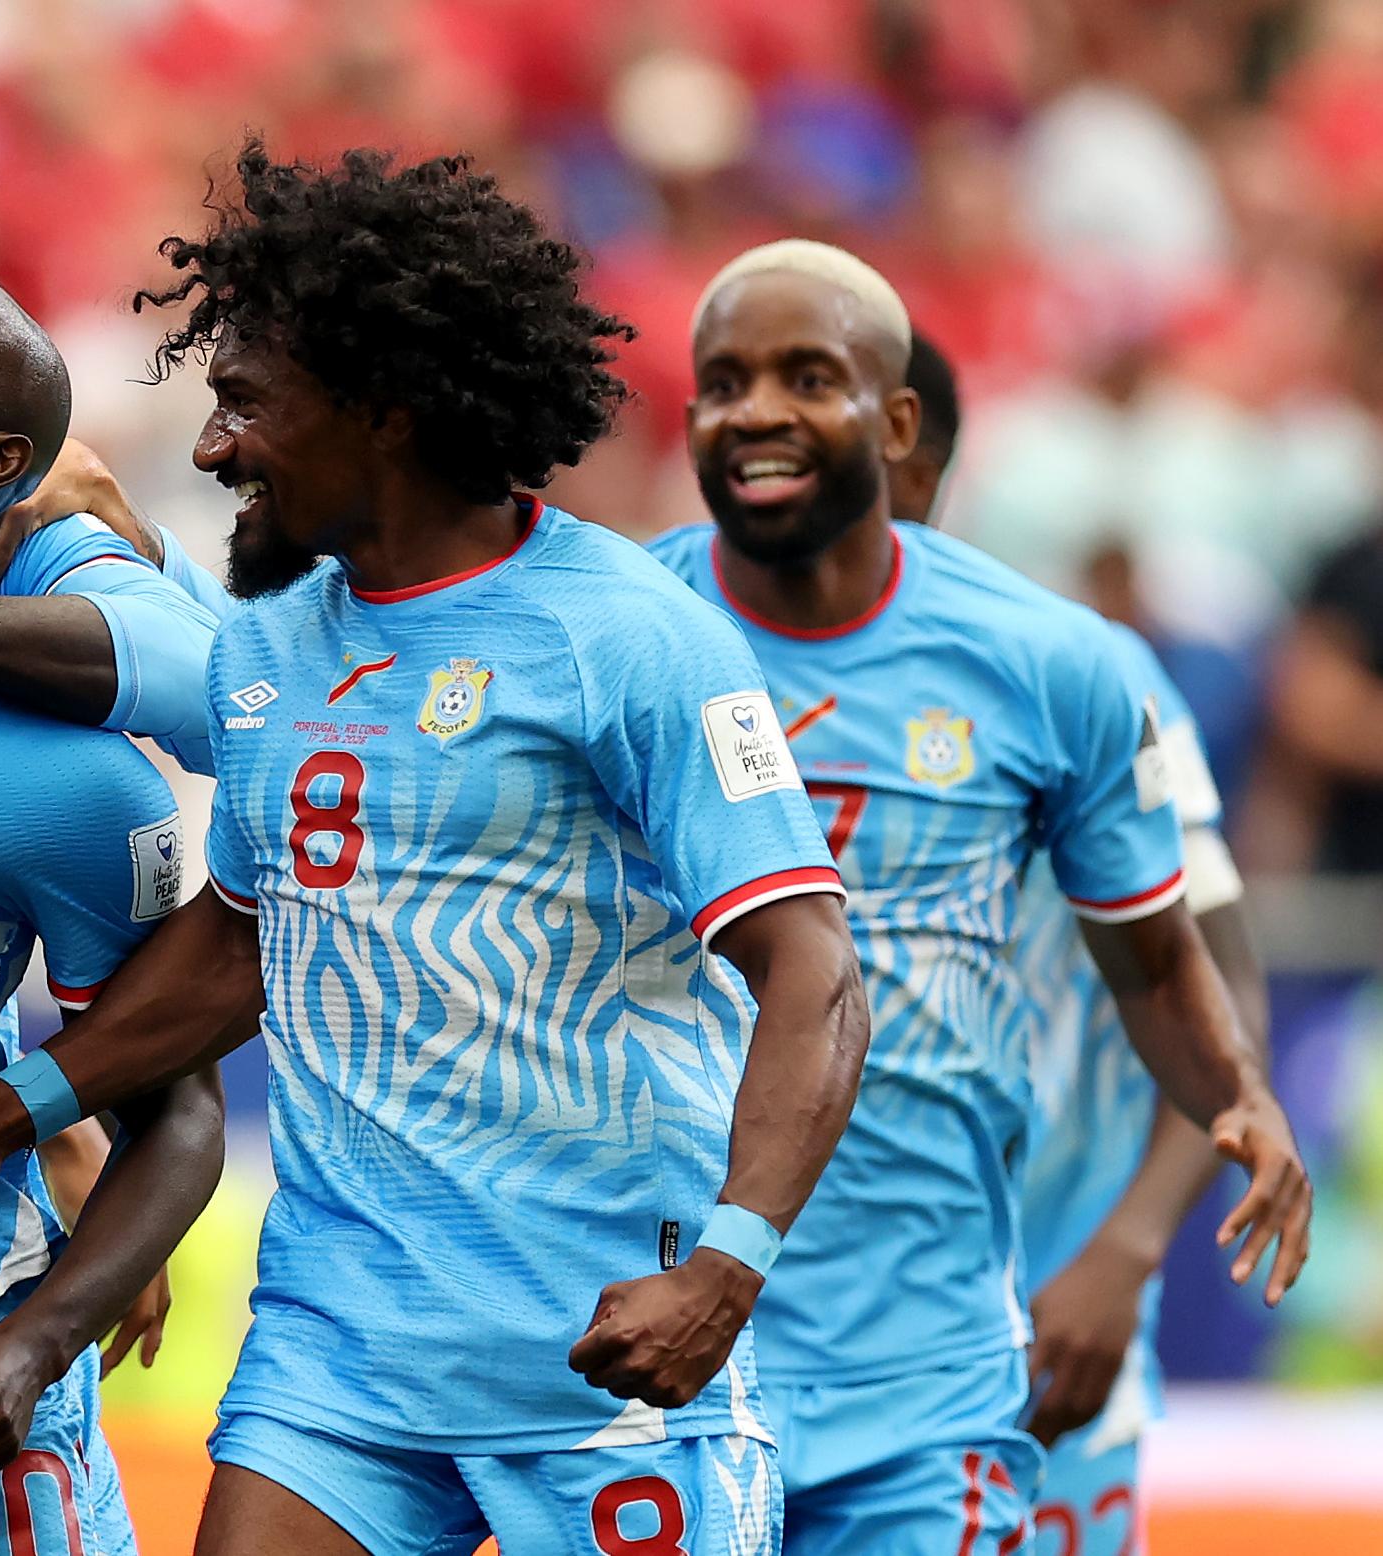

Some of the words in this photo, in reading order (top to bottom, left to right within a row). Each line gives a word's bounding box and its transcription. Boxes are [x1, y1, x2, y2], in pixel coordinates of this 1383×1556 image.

[225, 714, 265, 729] umbro
[293, 721, 338, 734] PORTUGAL
[359, 724, 389, 736] CONGO
[427, 719, 468, 734] FECOFA
[756, 770, 777, 781] FIFA
[289, 751, 365, 889] 8
